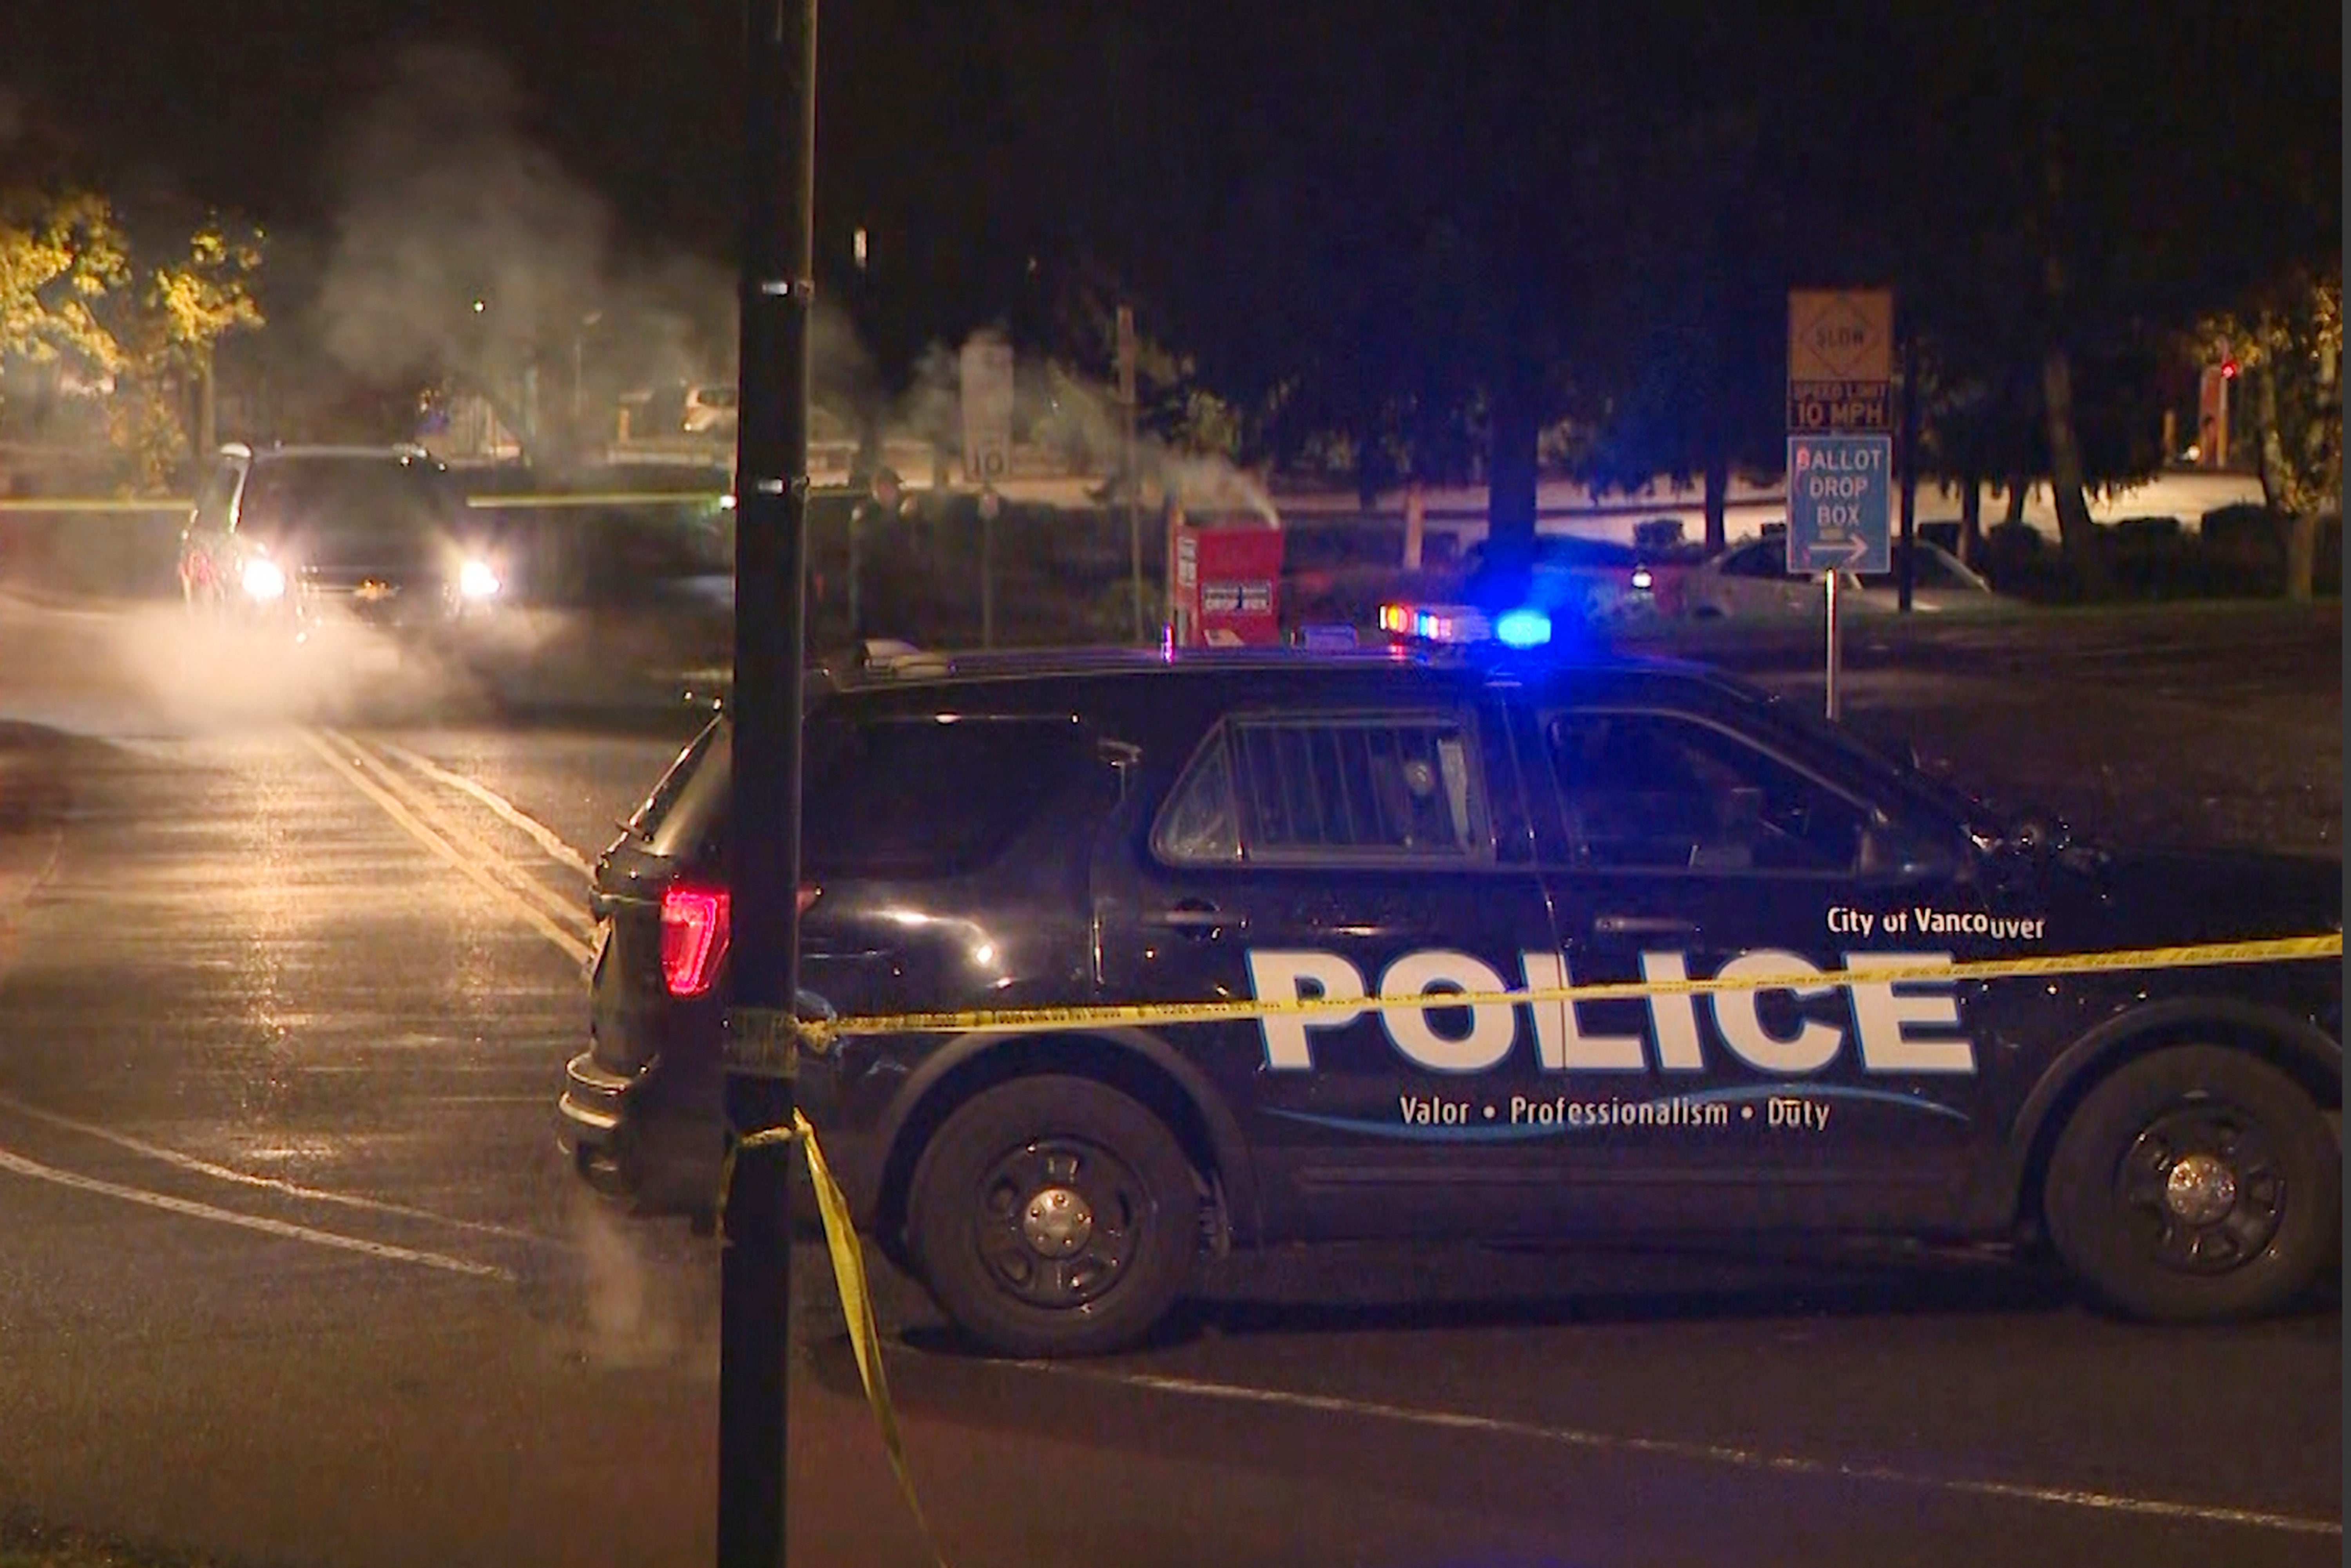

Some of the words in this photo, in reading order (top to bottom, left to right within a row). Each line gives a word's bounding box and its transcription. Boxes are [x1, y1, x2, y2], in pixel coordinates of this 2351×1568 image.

[1816, 327, 1865, 348] SLOW
[1798, 402, 1823, 425] 10
[1830, 402, 1882, 425] MPH
[1797, 449, 1881, 470] BALLOT
[1809, 477, 1868, 498] DROP
[1817, 506, 1859, 525] BOX
[1827, 907, 1873, 938] City
[1883, 909, 1907, 932] of
[1914, 908, 2045, 939] Vancouver
[1247, 950, 1976, 1073] POLICE
[1400, 1097, 1470, 1124] Valor
[1511, 1097, 1728, 1124] Professionalism
[1767, 1097, 1831, 1130] Duty
